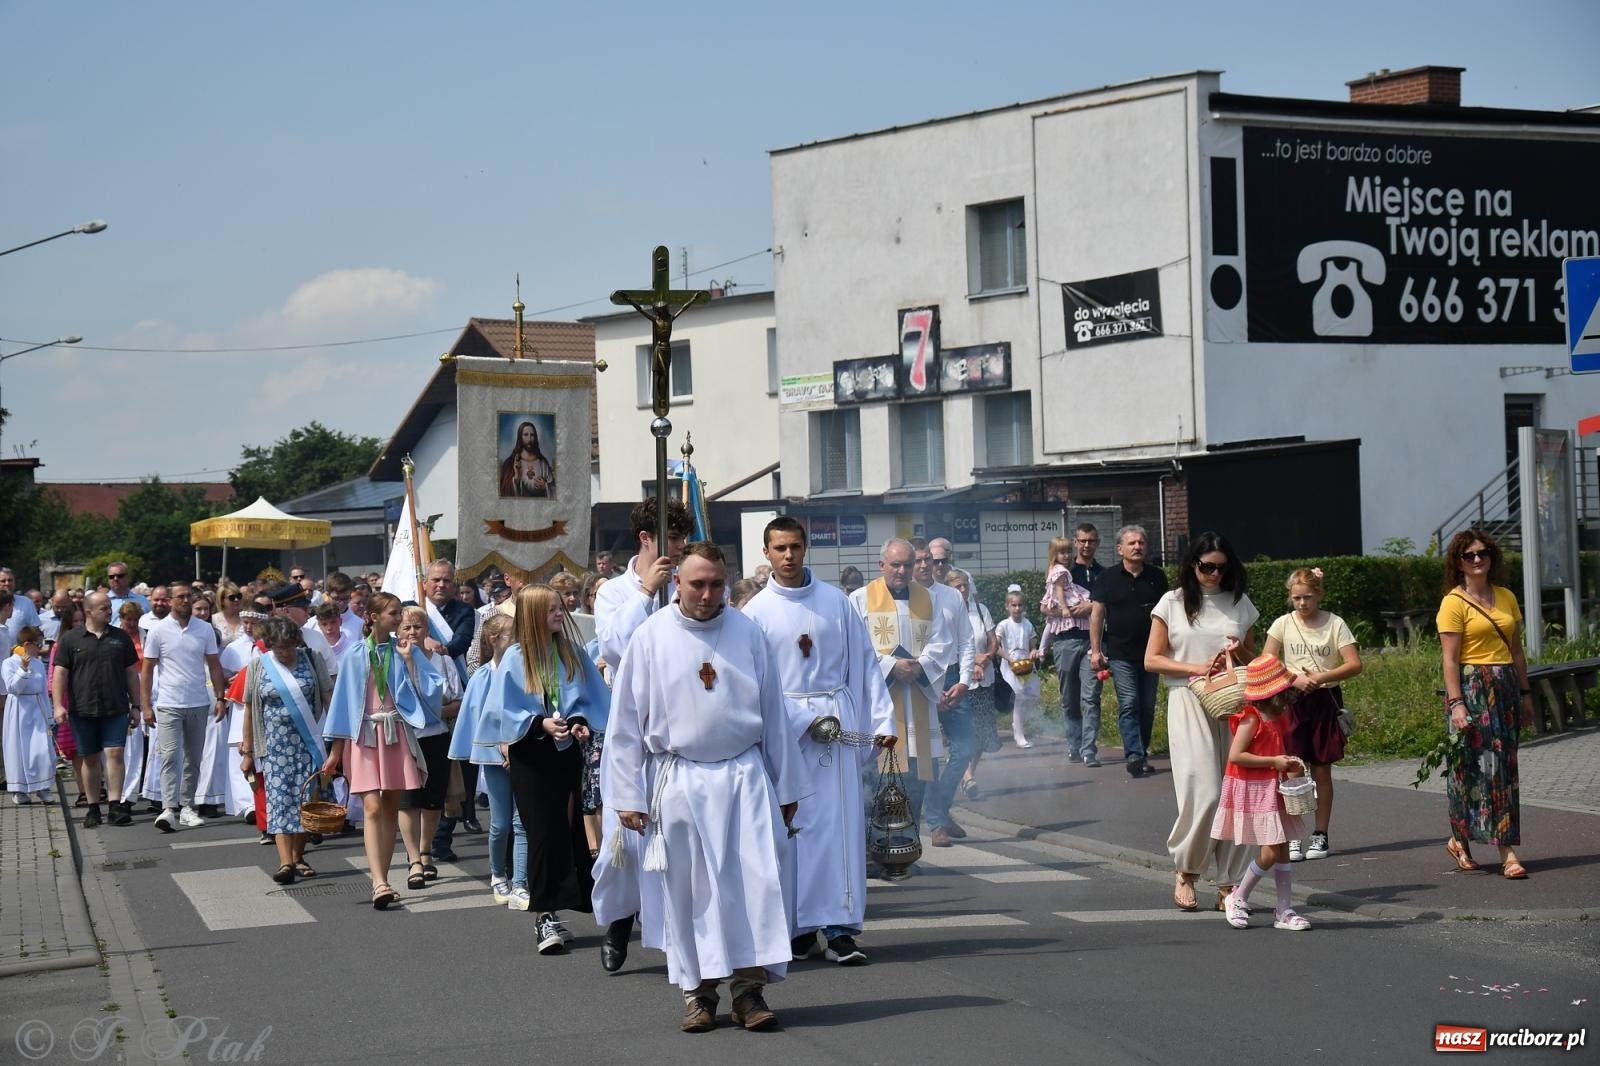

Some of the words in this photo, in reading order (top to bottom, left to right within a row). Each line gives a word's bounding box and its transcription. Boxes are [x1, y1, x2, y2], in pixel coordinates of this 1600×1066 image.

[1294, 138, 1323, 164] jest
[1326, 141, 1382, 163] bardzo
[1385, 144, 1433, 165] dobre
[1345, 175, 1465, 222] Miejsce
[1475, 188, 1513, 217] na
[1385, 217, 1481, 266] Twoją
[1074, 307, 1090, 321] do
[1091, 298, 1150, 320] wynajęcia
[1399, 276, 1464, 323] 666
[1477, 277, 1536, 323] 371
[1095, 325, 1111, 337] 666
[1112, 322, 1127, 334] 371
[901, 309, 933, 392] 7
[954, 518, 977, 529] CCC
[985, 521, 1038, 532] Paczkomat
[1041, 521, 1058, 532] 24h
[811, 533, 832, 541] SMART
